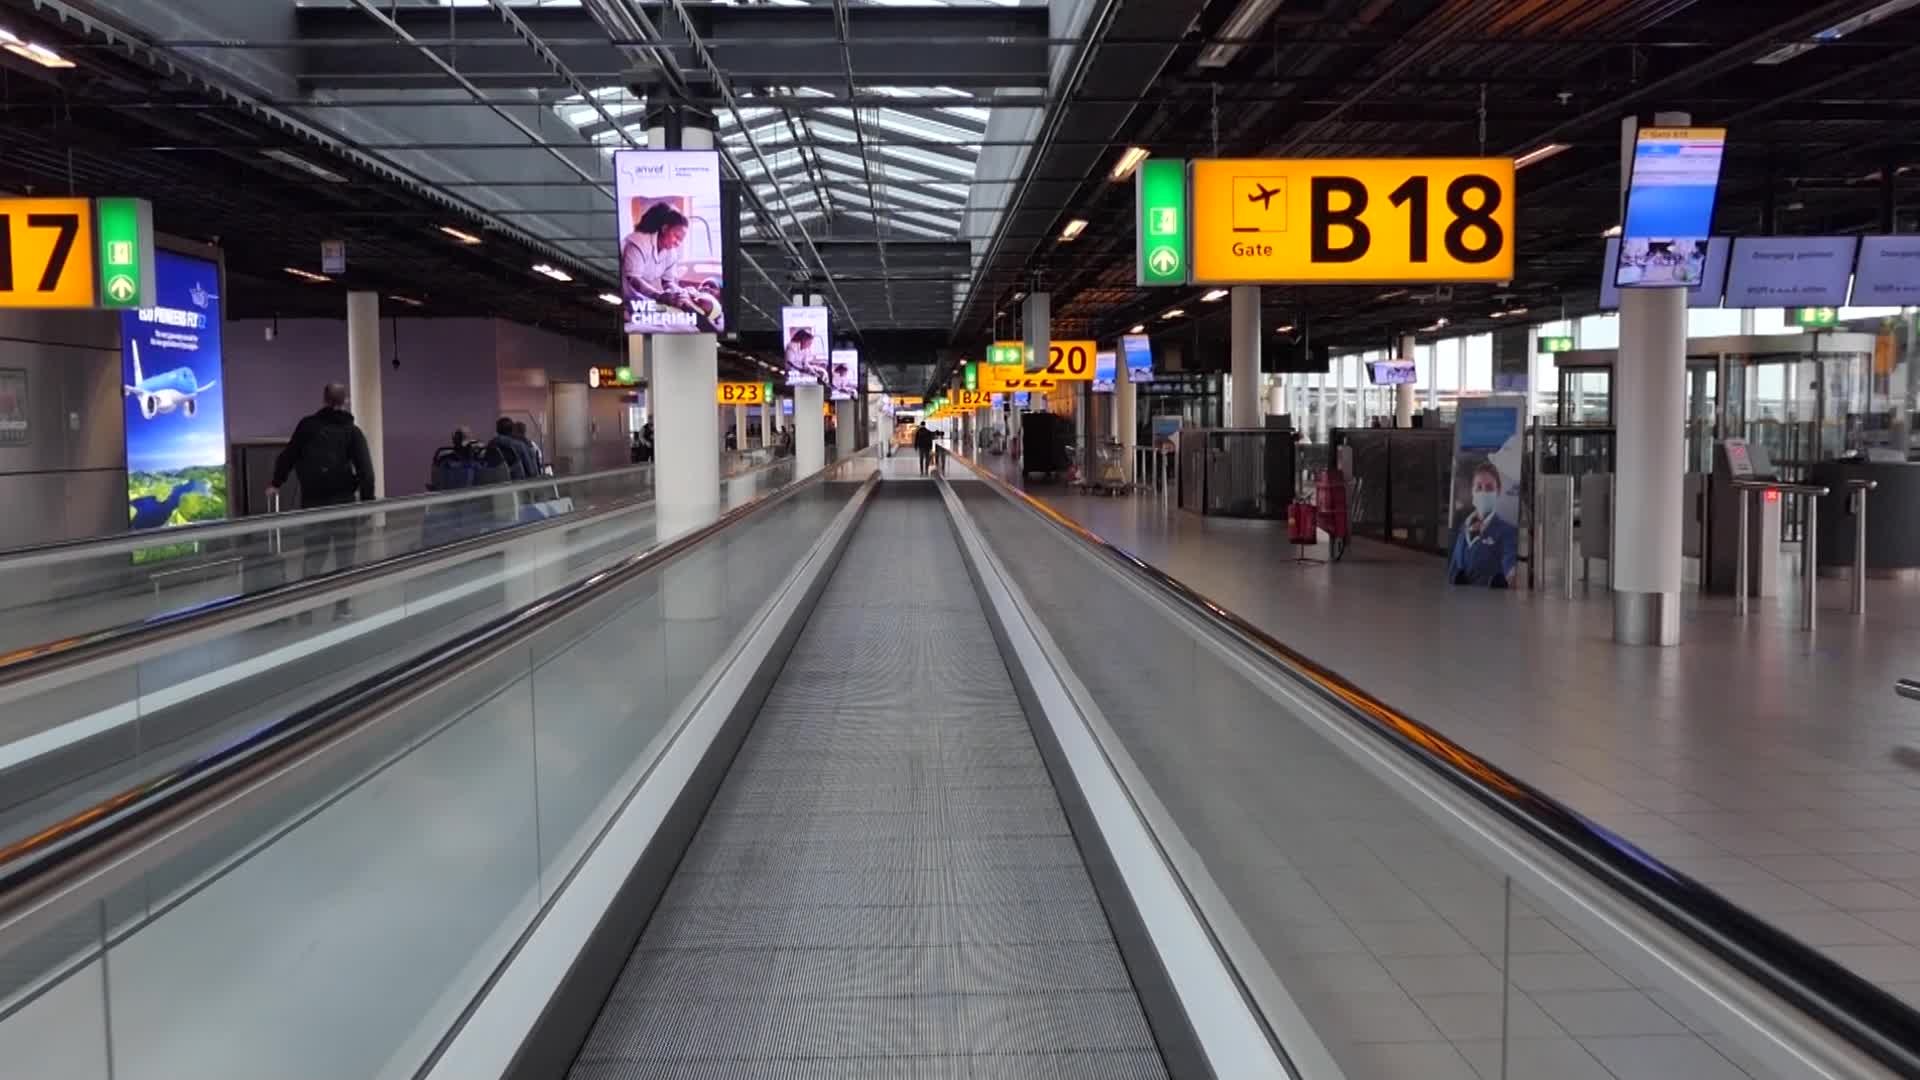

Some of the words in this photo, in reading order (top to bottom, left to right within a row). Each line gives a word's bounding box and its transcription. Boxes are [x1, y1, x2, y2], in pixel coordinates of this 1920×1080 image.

[1311, 174, 1504, 264] B18
[1232, 242, 1273, 257] Gate
[630, 300, 657, 312] WE
[631, 312, 698, 326] CHERISH
[1032, 346, 1087, 374] 20
[723, 384, 758, 400] B23
[963, 391, 991, 404] B24
